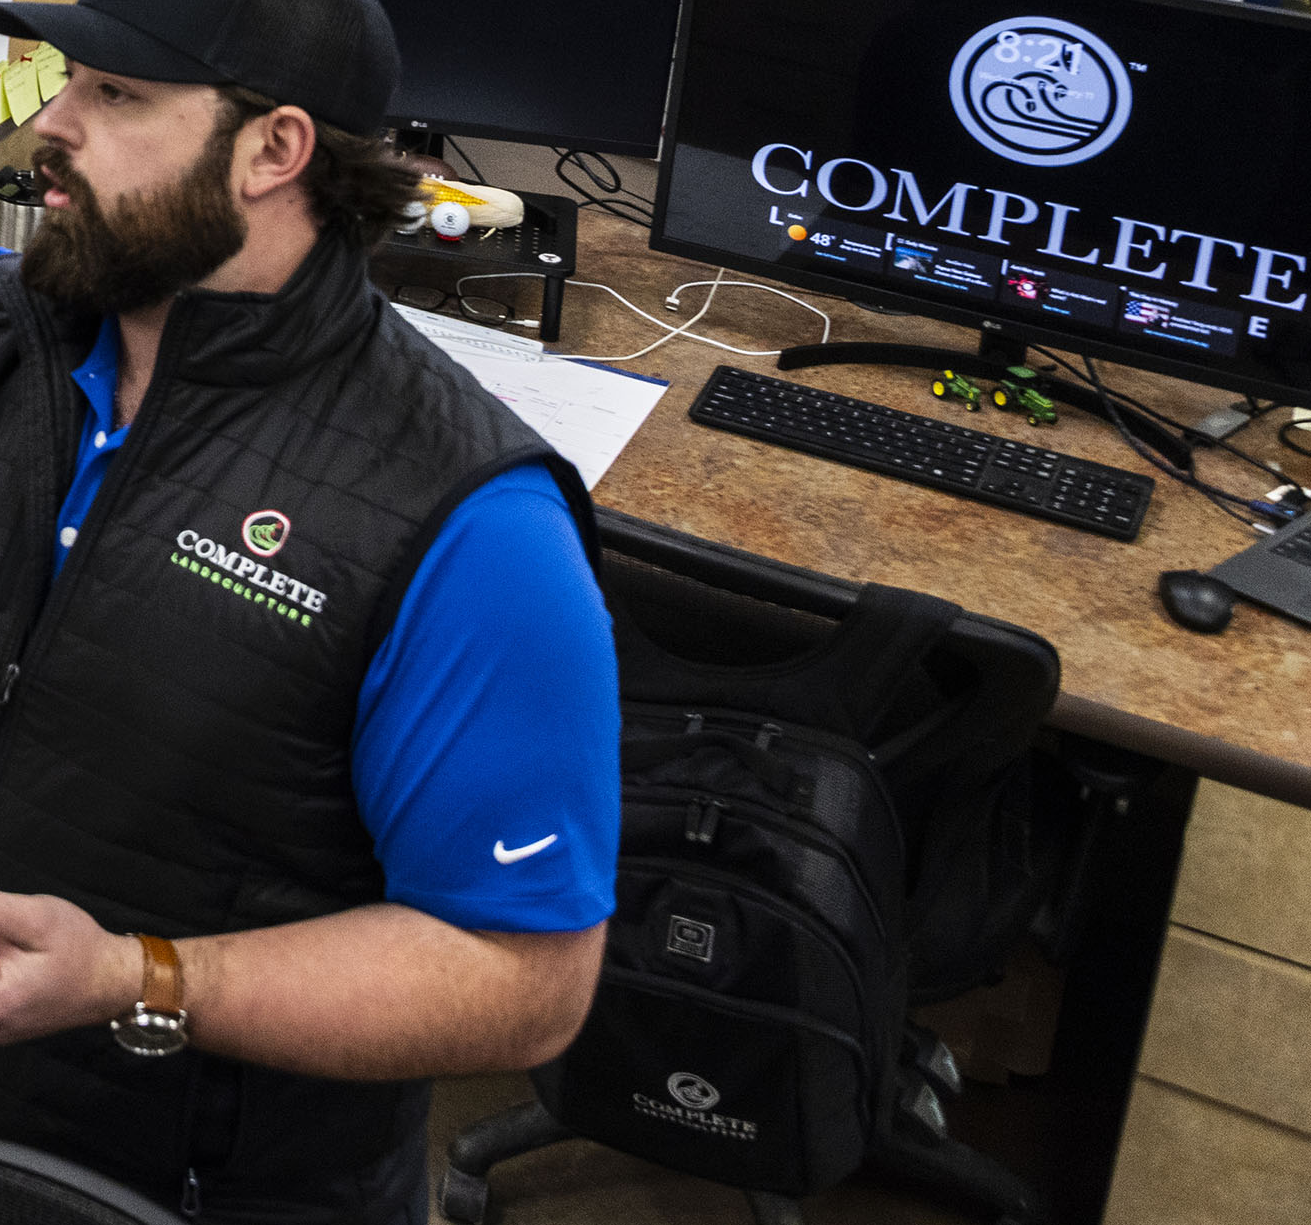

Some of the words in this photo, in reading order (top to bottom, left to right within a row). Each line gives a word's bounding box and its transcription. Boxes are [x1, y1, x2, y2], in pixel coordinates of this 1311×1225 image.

[993, 30, 1085, 77] 8:21
[751, 142, 1310, 313] COMPLETE
[170, 551, 314, 629] LANDSCULPTURE
[176, 529, 328, 614] COMPLETE
[632, 1091, 758, 1133] COMPLETE
